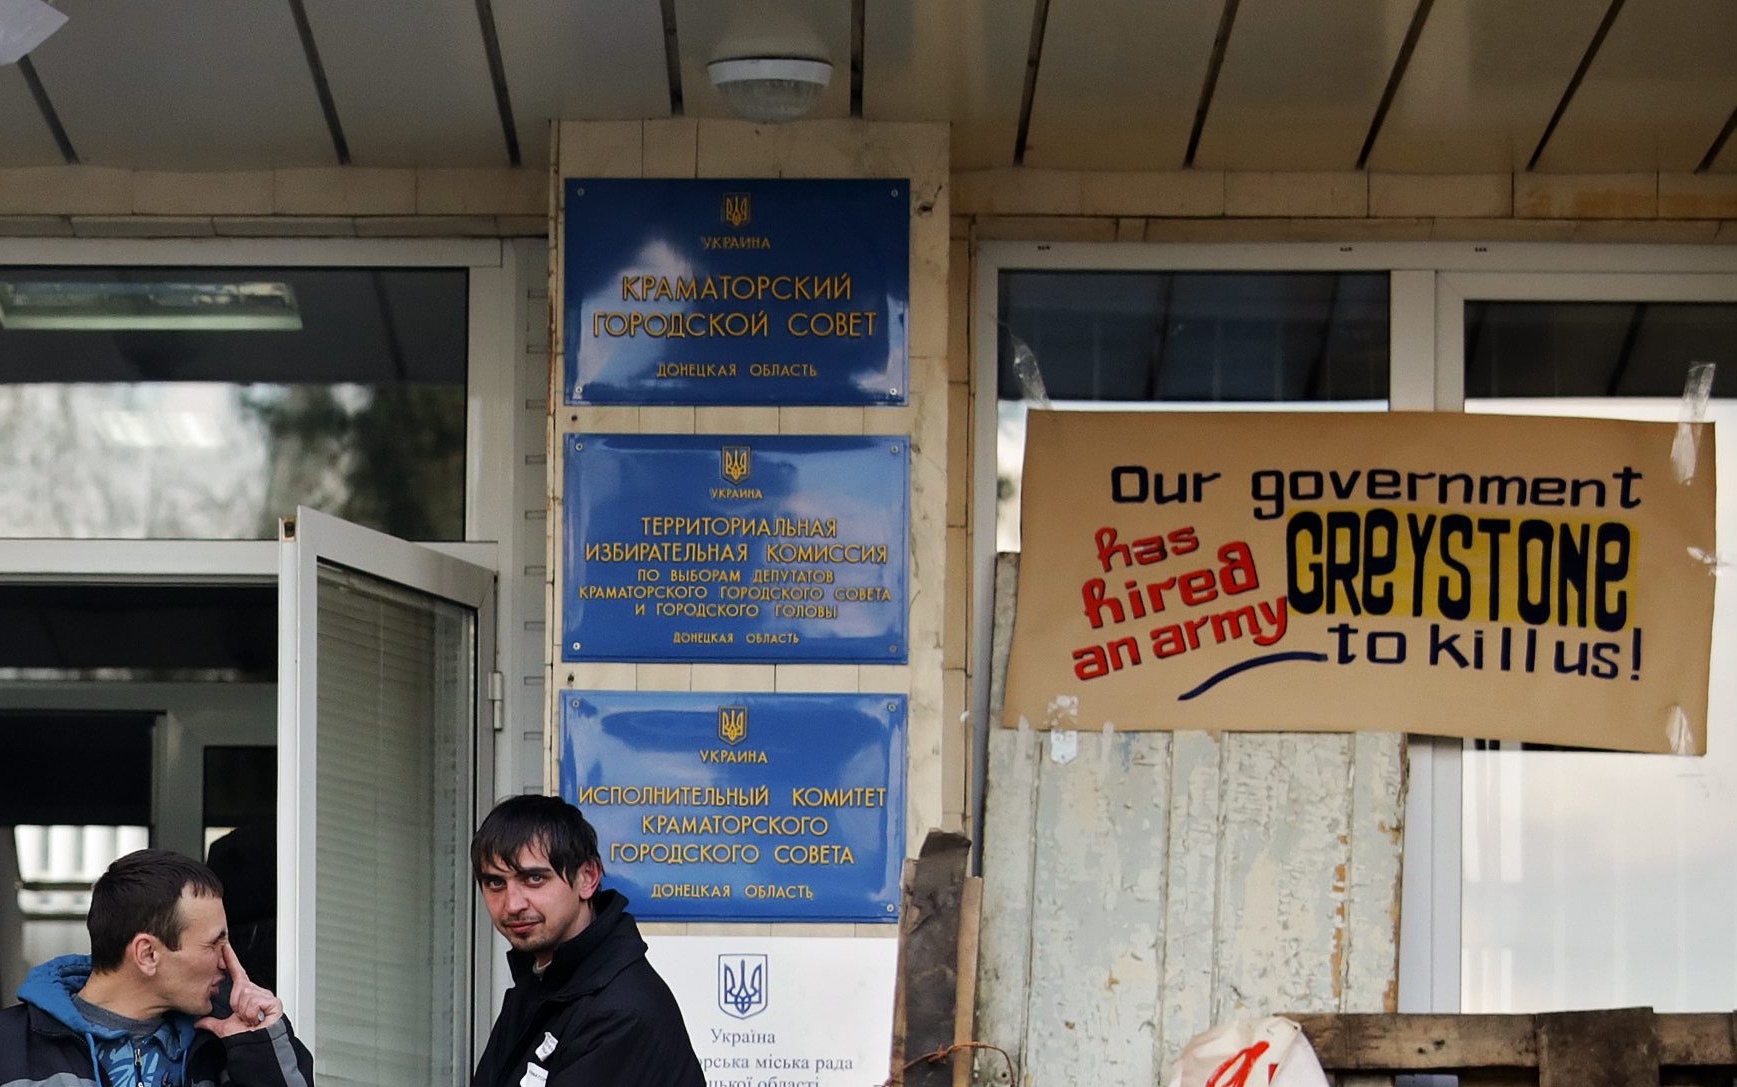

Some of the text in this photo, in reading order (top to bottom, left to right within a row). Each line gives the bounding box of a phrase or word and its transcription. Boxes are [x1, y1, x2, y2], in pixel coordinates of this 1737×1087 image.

[702, 237, 770, 249] УКРАИНА
[623, 272, 852, 301] КРАМАТОРСКИЙ
[593, 311, 876, 338] ГОРОДСКОЙ СОВЕТ
[656, 363, 817, 378] ДОНЕЦКАЯ ОБЛАСТЬ
[711, 489, 762, 499] УКРАИНА
[1112, 465, 1643, 520] Our government
[642, 517, 837, 538] ТЕРРИТОРИАЛЬНАЯ
[586, 543, 887, 563] ИЗБИРАТЕЛЬНАЯ КОМИССИЯ
[1094, 527, 1199, 573] has
[638, 569, 834, 584] ПО ВЫБОРАМ ДЕПУТАТОВ
[1081, 541, 1259, 629] hired
[579, 585, 891, 601] КРАМАТОРСКОГО ГОРОДСКОГО СОВЕТА
[634, 604, 837, 619] И ГОРОДСКОГО ГОЛОВЫ
[673, 632, 799, 645] ДОНЕЦКАЯ ОБЛАСТЬ
[1073, 595, 1289, 680] an army
[1328, 623, 1642, 680] to kill us!
[700, 750, 768, 763] УКРАИНА
[578, 785, 887, 807] ИСПОЛНИТЕЛЬНЫЙ КОМИТЕТ
[642, 815, 829, 836] КРАМАТОРСКОГО
[610, 843, 855, 866] ГОРОДСКОГО СОВЕТА
[651, 884, 813, 899] ДОНЕЦКАЯ ОБЛАСТЬ
[711, 1028, 775, 1046] Україна
[700, 1054, 853, 1073] рська міська рада
